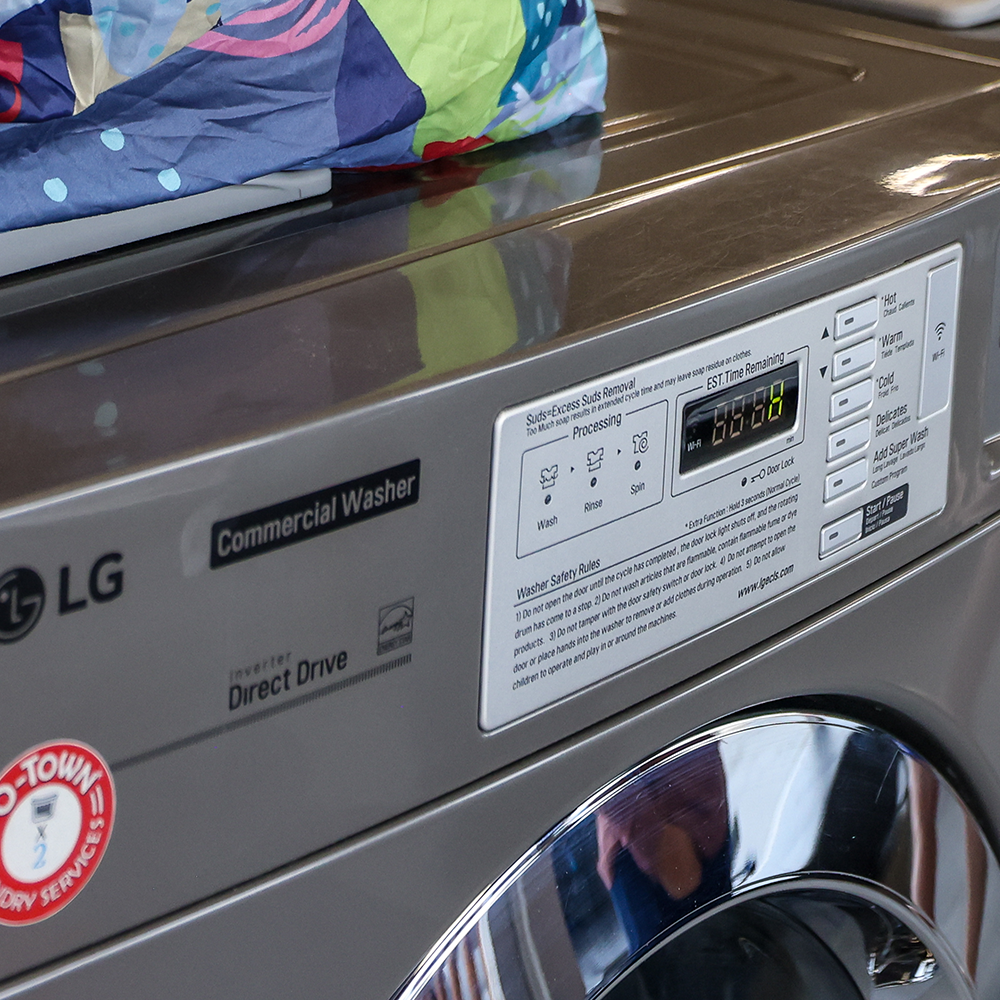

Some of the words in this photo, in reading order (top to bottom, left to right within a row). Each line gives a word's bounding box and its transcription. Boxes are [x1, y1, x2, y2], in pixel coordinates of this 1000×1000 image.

[745, 352, 784, 375] Remaining
[581, 390, 601, 406] Suds
[602, 377, 635, 398] Removal
[572, 413, 621, 439] Processing
[876, 404, 907, 426] Delicates
[873, 446, 888, 463] Add
[888, 437, 908, 455] Super
[910, 426, 928, 444] Wash
[766, 463, 780, 475] Door
[780, 456, 794, 469] Lock
[584, 499, 602, 512] Rinse
[630, 482, 645, 495] Spin
[865, 501, 881, 516] Start
[886, 490, 903, 505] Pause
[217, 497, 337, 557] Commercial
[342, 475, 416, 518] Washer
[537, 515, 557, 530] Wash
[514, 625, 532, 639] drum
[533, 620, 545, 631] has
[545, 612, 563, 626] come
[564, 608, 571, 617] to
[572, 606, 576, 614] a
[594, 594, 600, 605] 2)
[601, 592, 610, 602] Do
[610, 586, 621, 598] not
[622, 579, 639, 592] wash
[639, 570, 662, 585] articles
[663, 563, 675, 575] that
[675, 559, 685, 569] are
[717, 536, 738, 551] contain
[739, 523, 766, 540] flammable
[767, 517, 780, 528] fume
[781, 513, 786, 522] or
[787, 509, 797, 519] dye
[516, 610, 521, 621] 1)
[522, 609, 531, 619] Do
[532, 603, 543, 614] not
[544, 597, 561, 609] open
[562, 592, 572, 602] the
[573, 585, 588, 597] door
[589, 577, 603, 591] until
[604, 574, 615, 584] the
[615, 566, 632, 579] cycle
[633, 561, 644, 572] has
[680, 542, 690, 552] the
[690, 535, 703, 547] door
[704, 529, 716, 541] lock
[717, 523, 730, 536] light
[730, 517, 746, 530] shuts
[756, 506, 767, 518] and
[768, 503, 777, 513] the
[777, 493, 798, 508] rotating
[58, 552, 125, 616] LG
[517, 579, 548, 599] Washer
[550, 568, 577, 586] Safety
[578, 558, 600, 575] Rules
[549, 630, 556, 641] 3)
[556, 627, 565, 637] Do
[566, 622, 577, 633] not
[578, 612, 600, 628] tamper
[601, 605, 615, 618] with
[616, 601, 627, 611] the
[627, 594, 641, 606] door
[642, 586, 661, 600] safety
[662, 576, 682, 591] switch
[683, 573, 689, 582] or
[690, 567, 703, 579] door
[719, 555, 725, 565] 4)
[727, 552, 735, 562] Do
[735, 547, 745, 558] not
[745, 537, 766, 553] attempt
[767, 535, 773, 543] to
[773, 529, 786, 540] open
[787, 524, 795, 534] the
[513, 660, 527, 673] door
[529, 657, 536, 666] or
[537, 649, 555, 664] place
[556, 639, 575, 654] hands
[576, 634, 589, 645] into
[589, 629, 600, 639] the
[601, 618, 624, 634] washer
[625, 615, 632, 623] to
[632, 604, 654, 620] remove
[655, 601, 662, 610] or
[662, 594, 674, 607] add
[674, 586, 696, 601] clothes
[696, 577, 715, 591] during
[746, 558, 752, 568] 5)
[753, 555, 761, 565] Do
[761, 550, 770, 561] not
[771, 544, 785, 556] allow
[512, 672, 538, 690] children
[539, 669, 546, 678] to
[547, 657, 572, 674] operate
[573, 650, 585, 663] and
[585, 646, 599, 659] play
[600, 642, 606, 650] in
[607, 639, 614, 648] or
[614, 627, 636, 644] around
[637, 624, 647, 634] the
[228, 668, 292, 711] Direct
[296, 651, 348, 687] Drive
[40, 817, 105, 907] SERVICES
